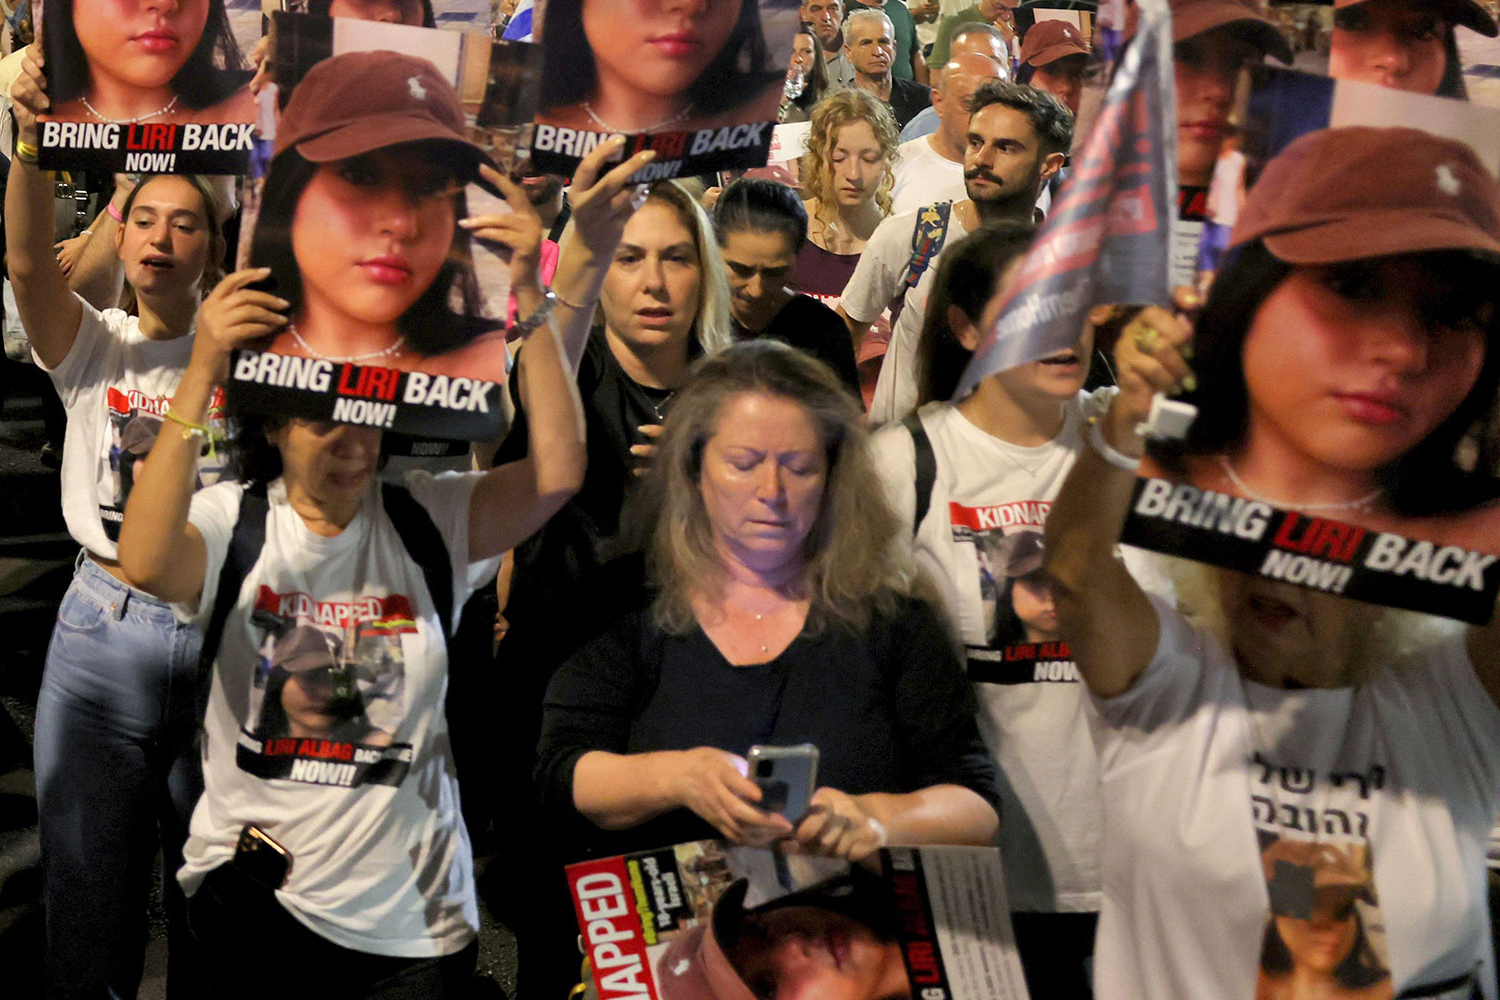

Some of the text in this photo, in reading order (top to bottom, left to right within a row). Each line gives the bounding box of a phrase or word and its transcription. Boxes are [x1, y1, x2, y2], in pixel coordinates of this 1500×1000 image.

[42, 121, 256, 151] BRING LIRI BACK
[689, 121, 768, 156] BACK
[125, 152, 177, 173] NOW!
[234, 351, 494, 413] BRING LIRI BACK
[332, 397, 398, 428] NOW!
[1134, 477, 1497, 592] BRING LIRI BACK
[1260, 549, 1353, 594] NOW!
[297, 737, 354, 760] ALBAG
[290, 759, 358, 786] NOW!!
[576, 872, 650, 1000] APPED
